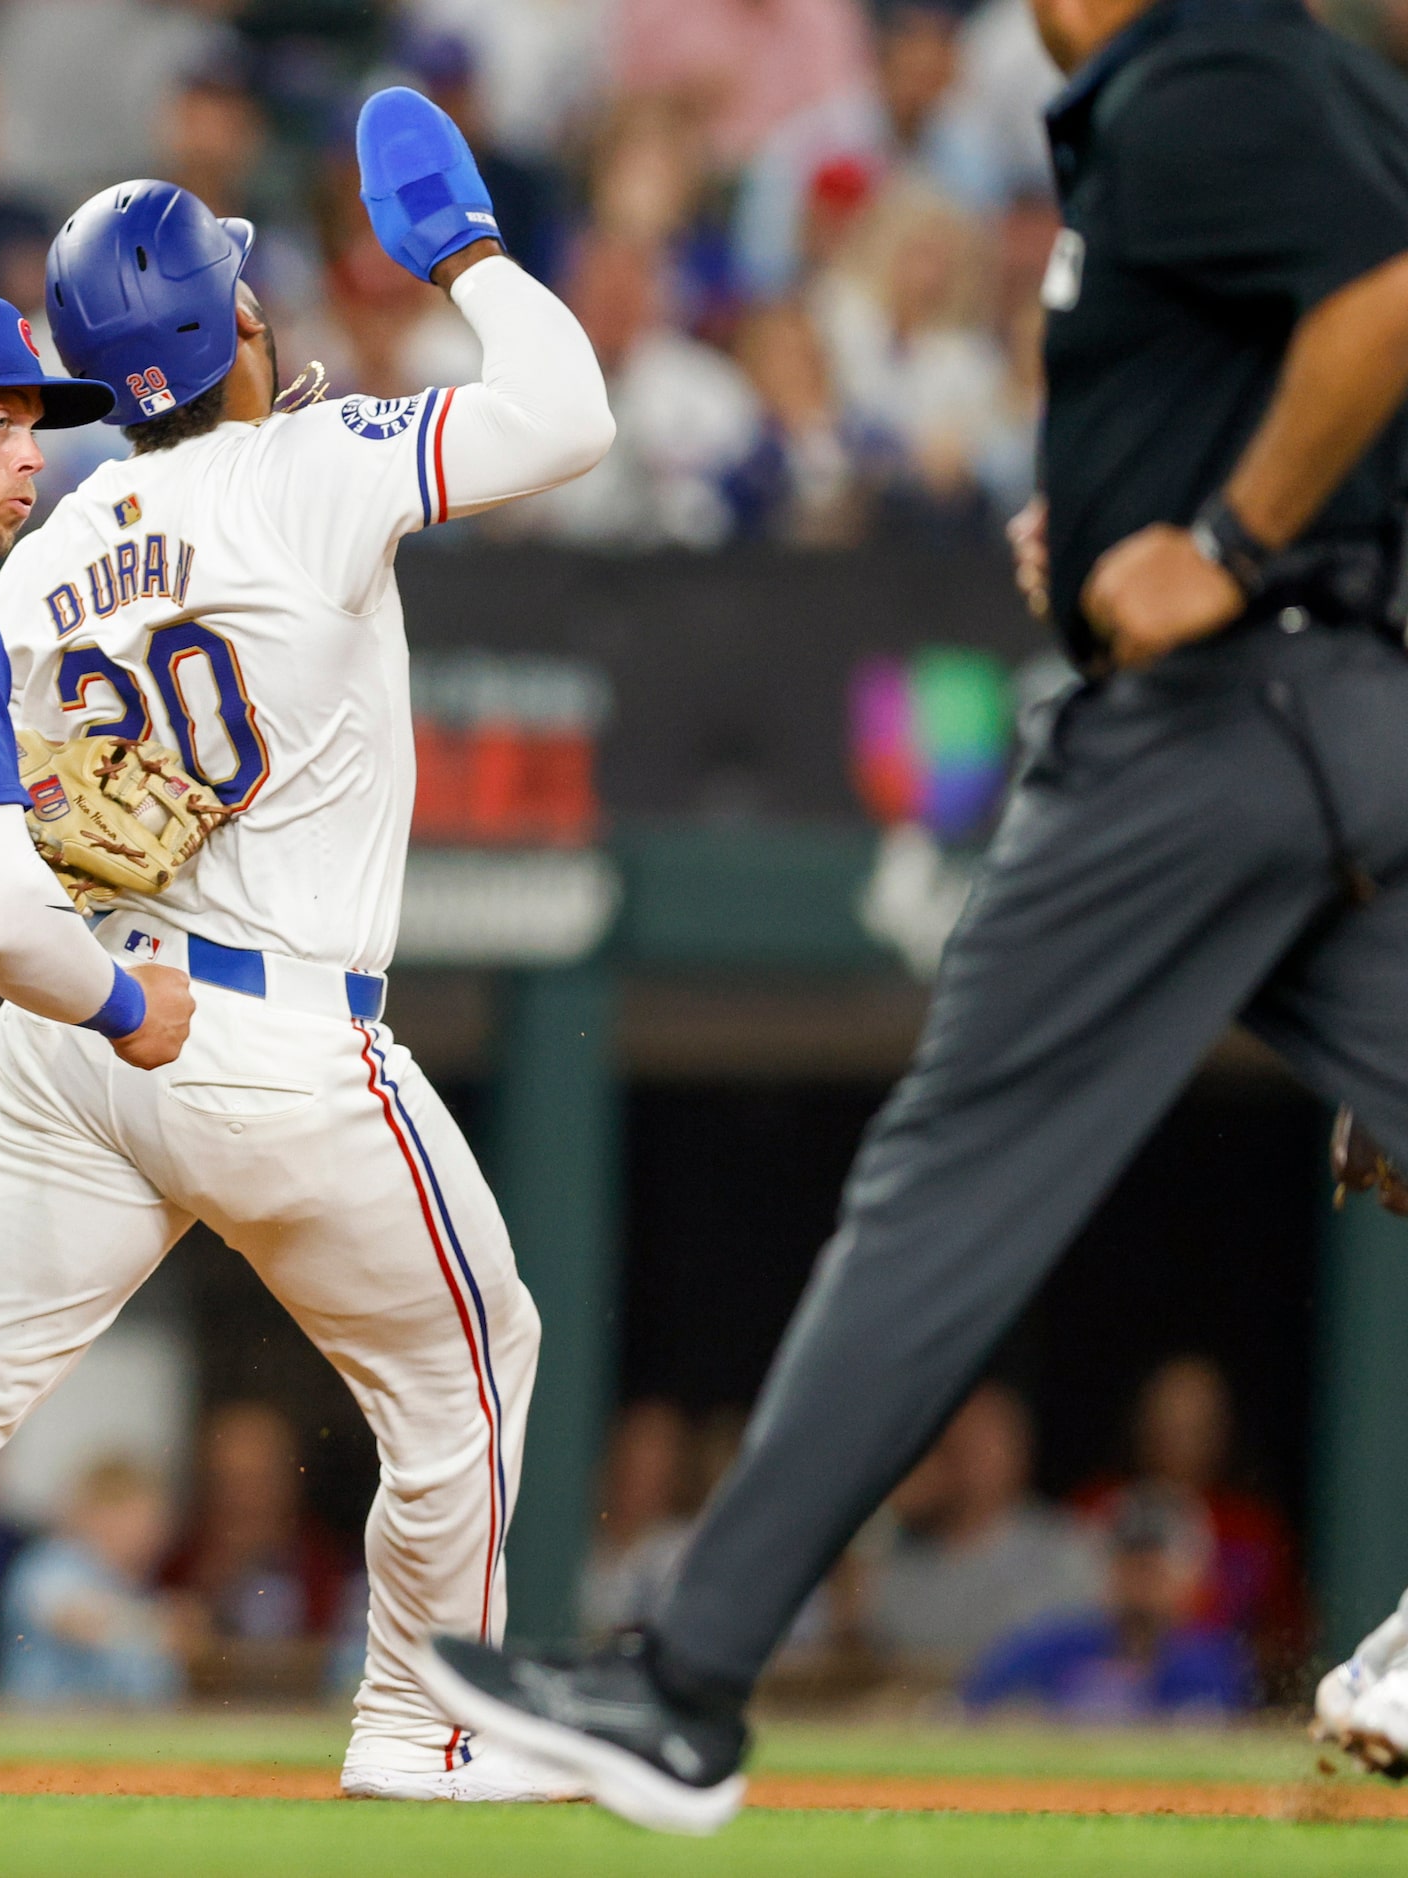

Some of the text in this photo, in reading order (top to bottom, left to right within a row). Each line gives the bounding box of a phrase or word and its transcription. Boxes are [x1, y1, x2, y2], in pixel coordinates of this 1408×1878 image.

[126, 366, 168, 399] 20
[44, 533, 195, 641] DURAN
[56, 618, 271, 815] 20
